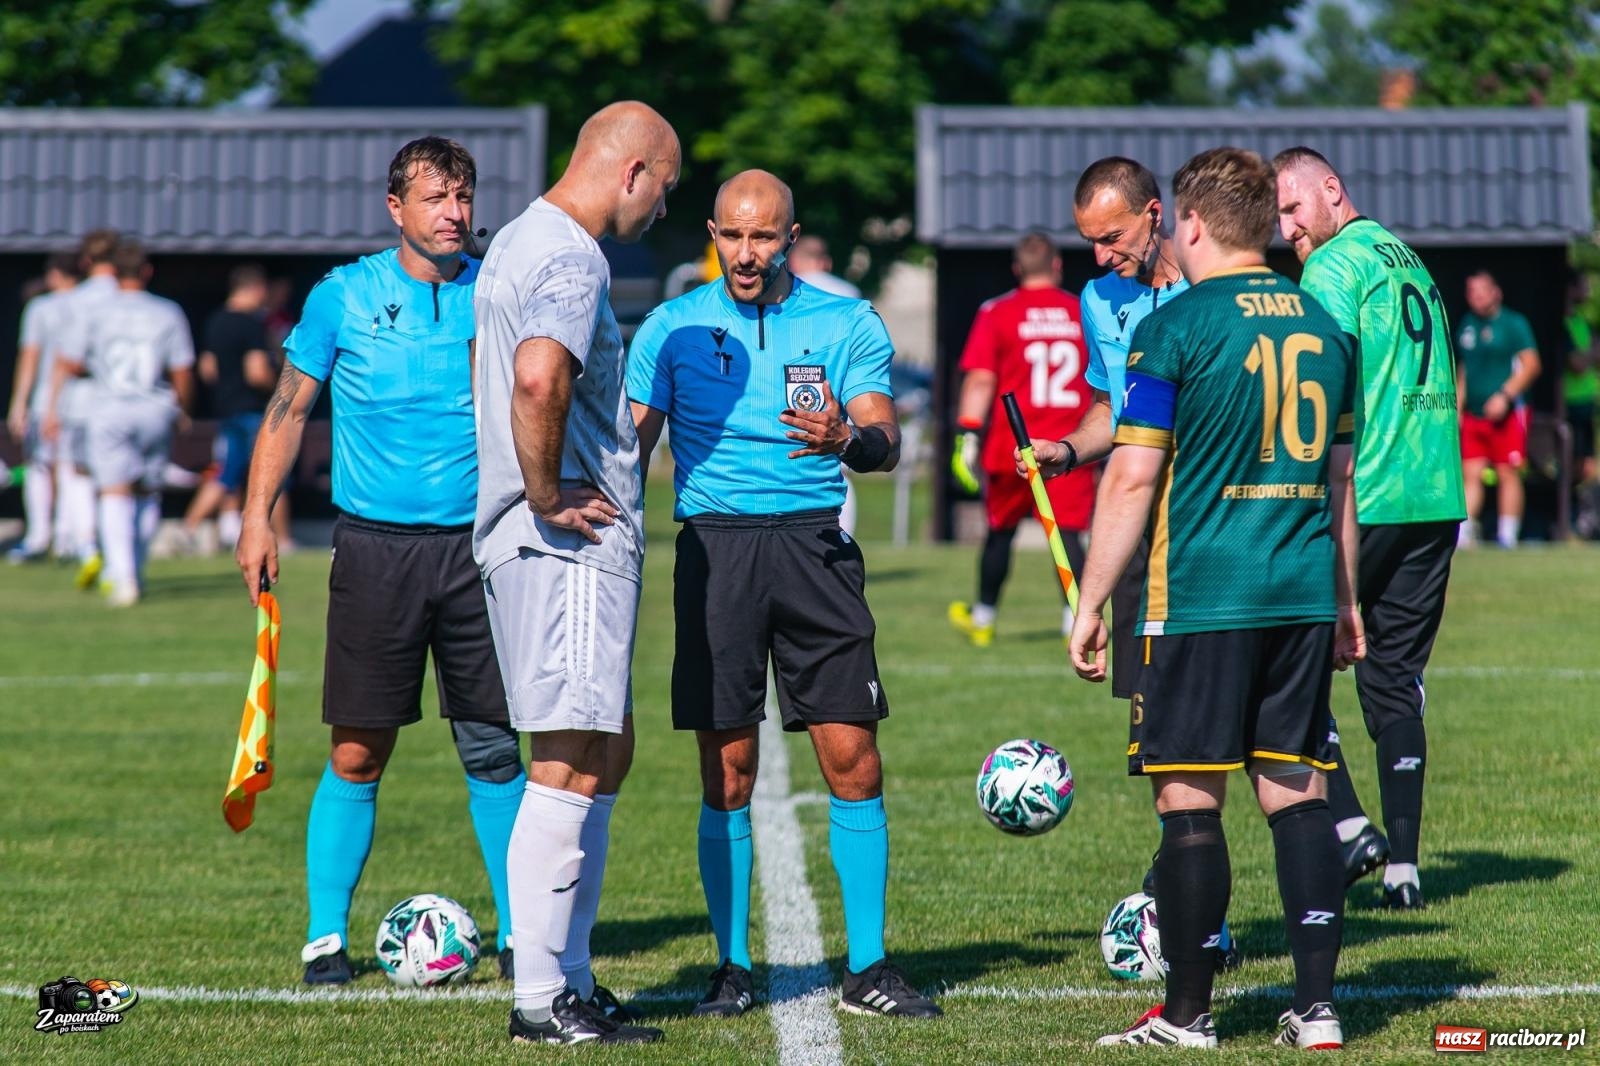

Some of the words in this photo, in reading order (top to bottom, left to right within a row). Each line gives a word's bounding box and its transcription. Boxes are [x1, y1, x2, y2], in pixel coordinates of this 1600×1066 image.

[1235, 292, 1305, 318] START
[788, 366, 822, 375] KOLEGIUM
[1023, 340, 1081, 409] 12
[1243, 332, 1328, 463] 16
[1222, 483, 1297, 499] PIETROWICE
